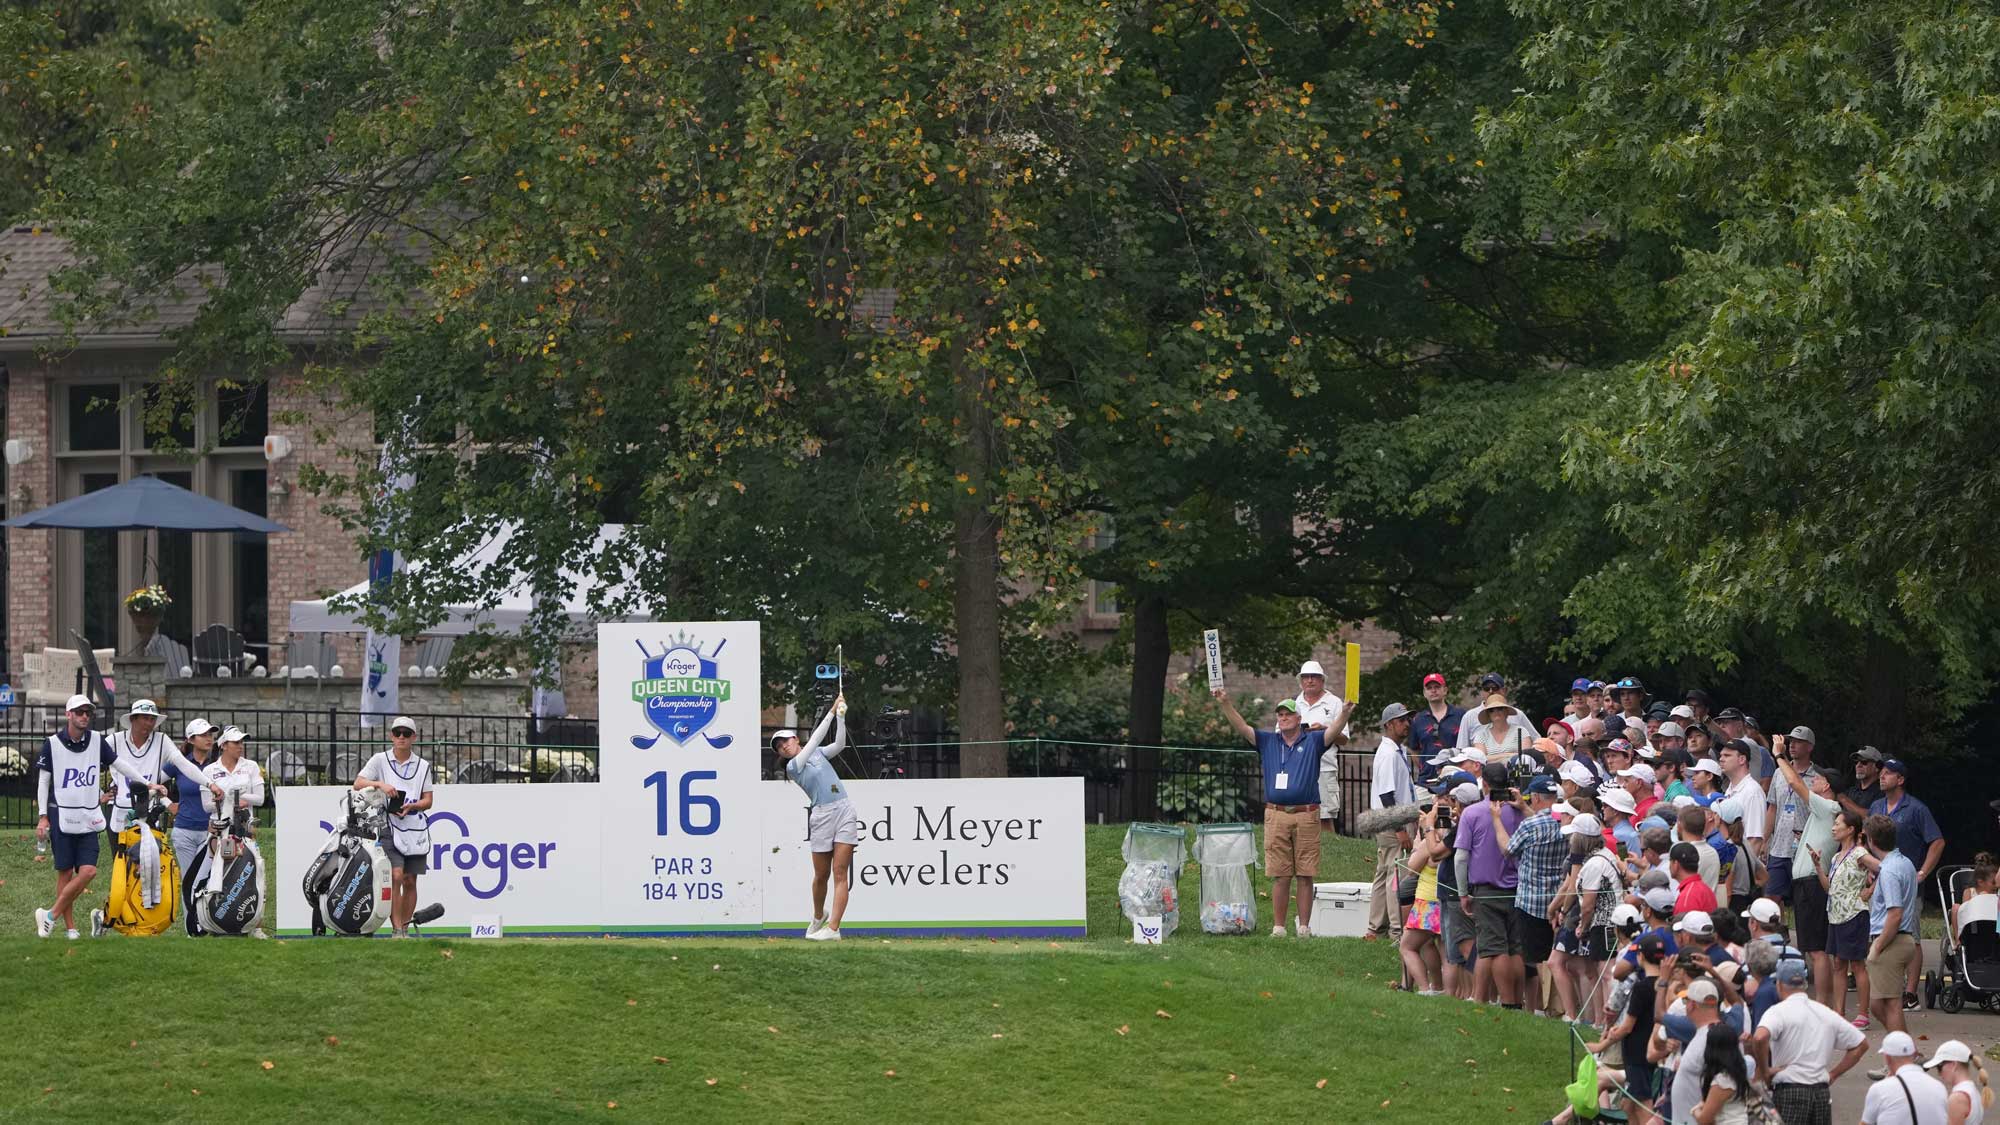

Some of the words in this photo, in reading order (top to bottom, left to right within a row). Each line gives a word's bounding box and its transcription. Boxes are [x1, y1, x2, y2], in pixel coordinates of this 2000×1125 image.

[666, 658, 696, 675] Kroger
[1208, 643, 1218, 678] QUIET
[634, 679, 688, 697] QUEEN
[692, 679, 727, 695] CITY
[649, 695, 713, 713] Championship
[62, 765, 97, 789] P&G
[643, 770, 721, 836] 16
[912, 805, 1043, 848] Meyer
[654, 857, 694, 875] PAR
[700, 857, 713, 875] 3
[215, 861, 255, 920] SMOKE
[332, 860, 370, 920] SMOKE
[642, 882, 678, 900] 184
[683, 882, 723, 900] YDS
[236, 894, 257, 922] Callaway
[352, 893, 372, 921] Callaway
[475, 925, 496, 936] P&G
